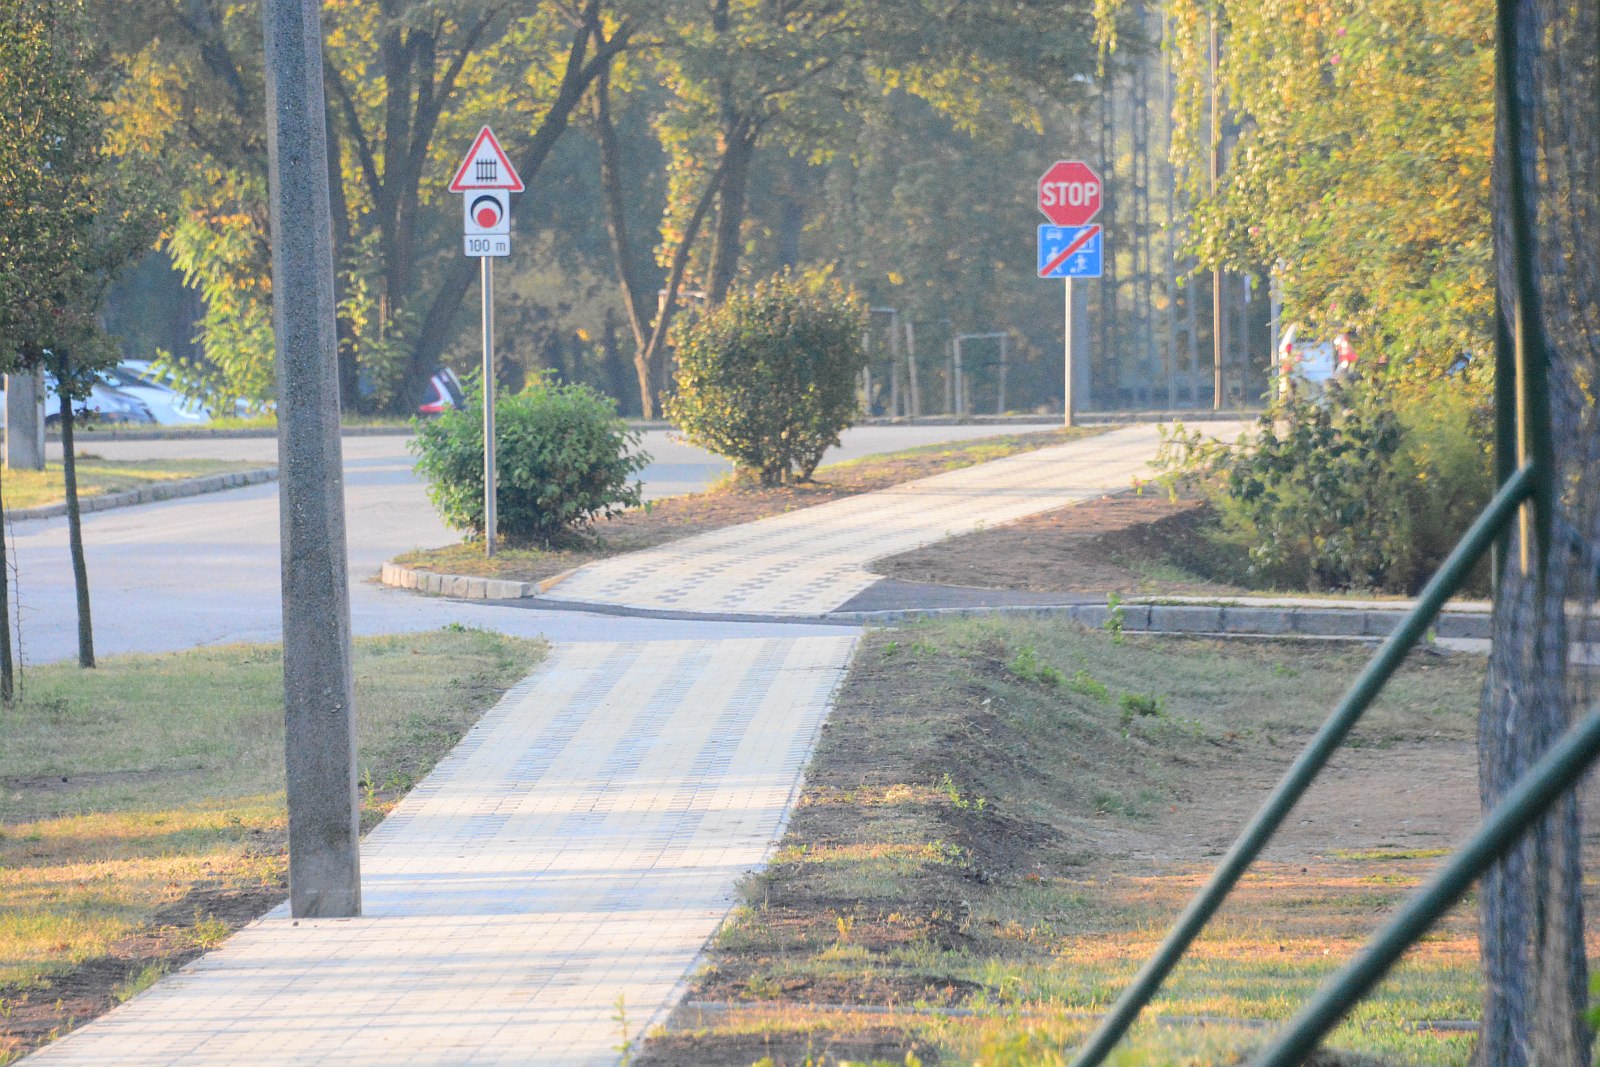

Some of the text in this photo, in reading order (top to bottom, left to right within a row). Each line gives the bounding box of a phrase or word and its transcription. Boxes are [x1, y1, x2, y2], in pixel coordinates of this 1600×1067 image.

[1042, 182, 1098, 206] STOP
[469, 239, 506, 252] 100 m
